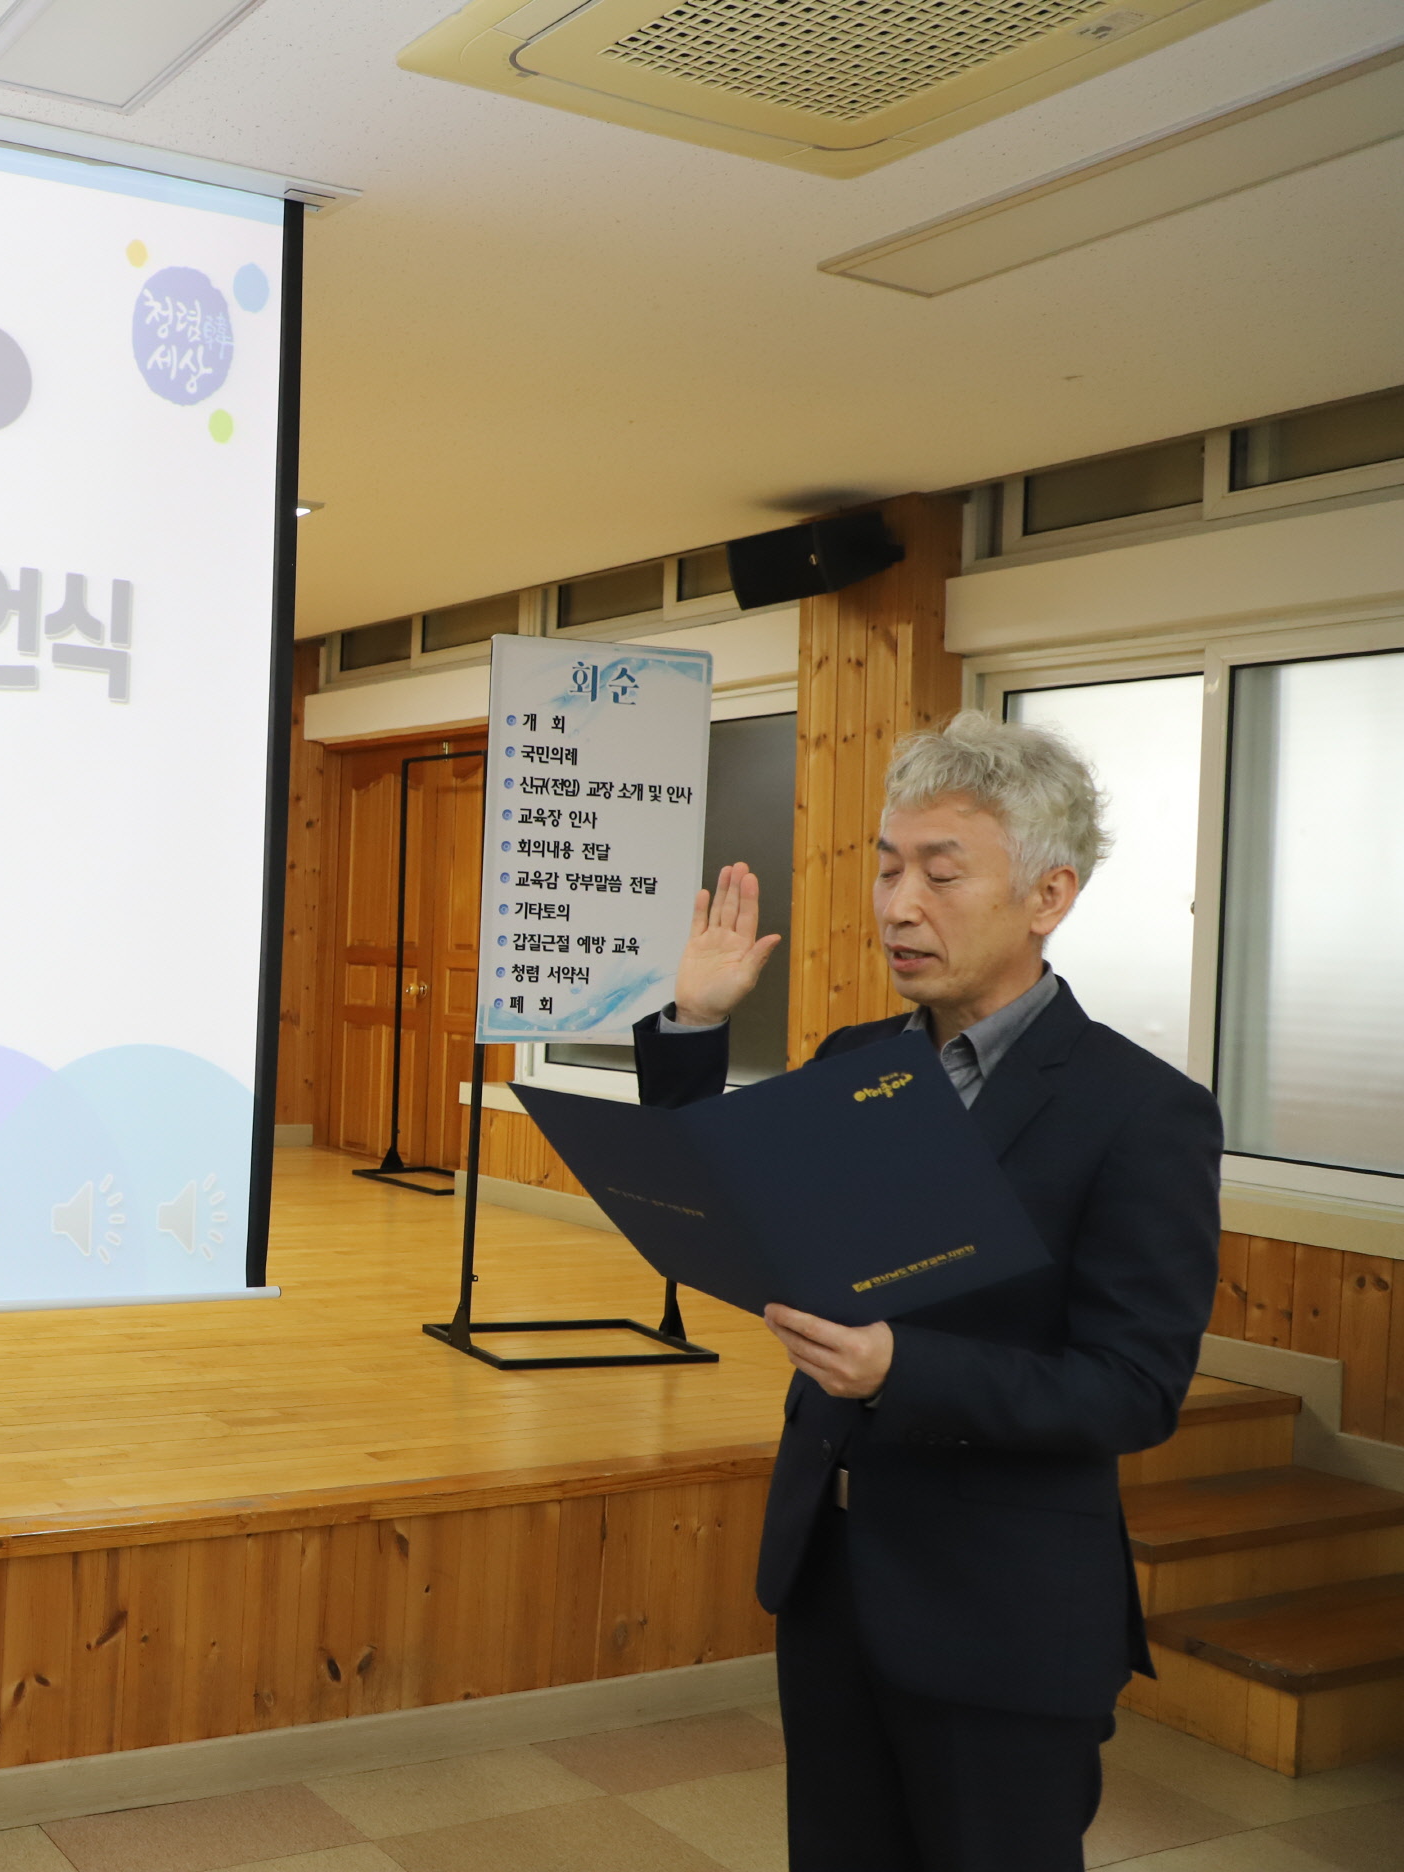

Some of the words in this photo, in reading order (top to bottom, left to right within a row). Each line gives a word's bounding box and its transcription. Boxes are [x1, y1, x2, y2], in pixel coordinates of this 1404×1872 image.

[146, 344, 213, 395] 세상
[521, 745, 578, 766] 국민의례
[586, 781, 614, 799] 교장
[617, 783, 644, 802] 소개
[648, 785, 662, 802] 및
[666, 786, 693, 805] 인사
[518, 808, 562, 827] 교육장
[569, 811, 598, 830] 인사
[517, 839, 574, 860] 회의내용
[582, 843, 611, 861] 전달
[515, 871, 559, 890] 교육감
[566, 873, 622, 893] 당부말씀
[629, 876, 658, 895] 전달
[514, 902, 571, 922] 기타토의
[512, 933, 570, 953] 갑질근절
[577, 937, 606, 955] 예방
[611, 938, 640, 956] 교육
[511, 964, 540, 983] 청렴
[547, 966, 590, 985] 서약식
